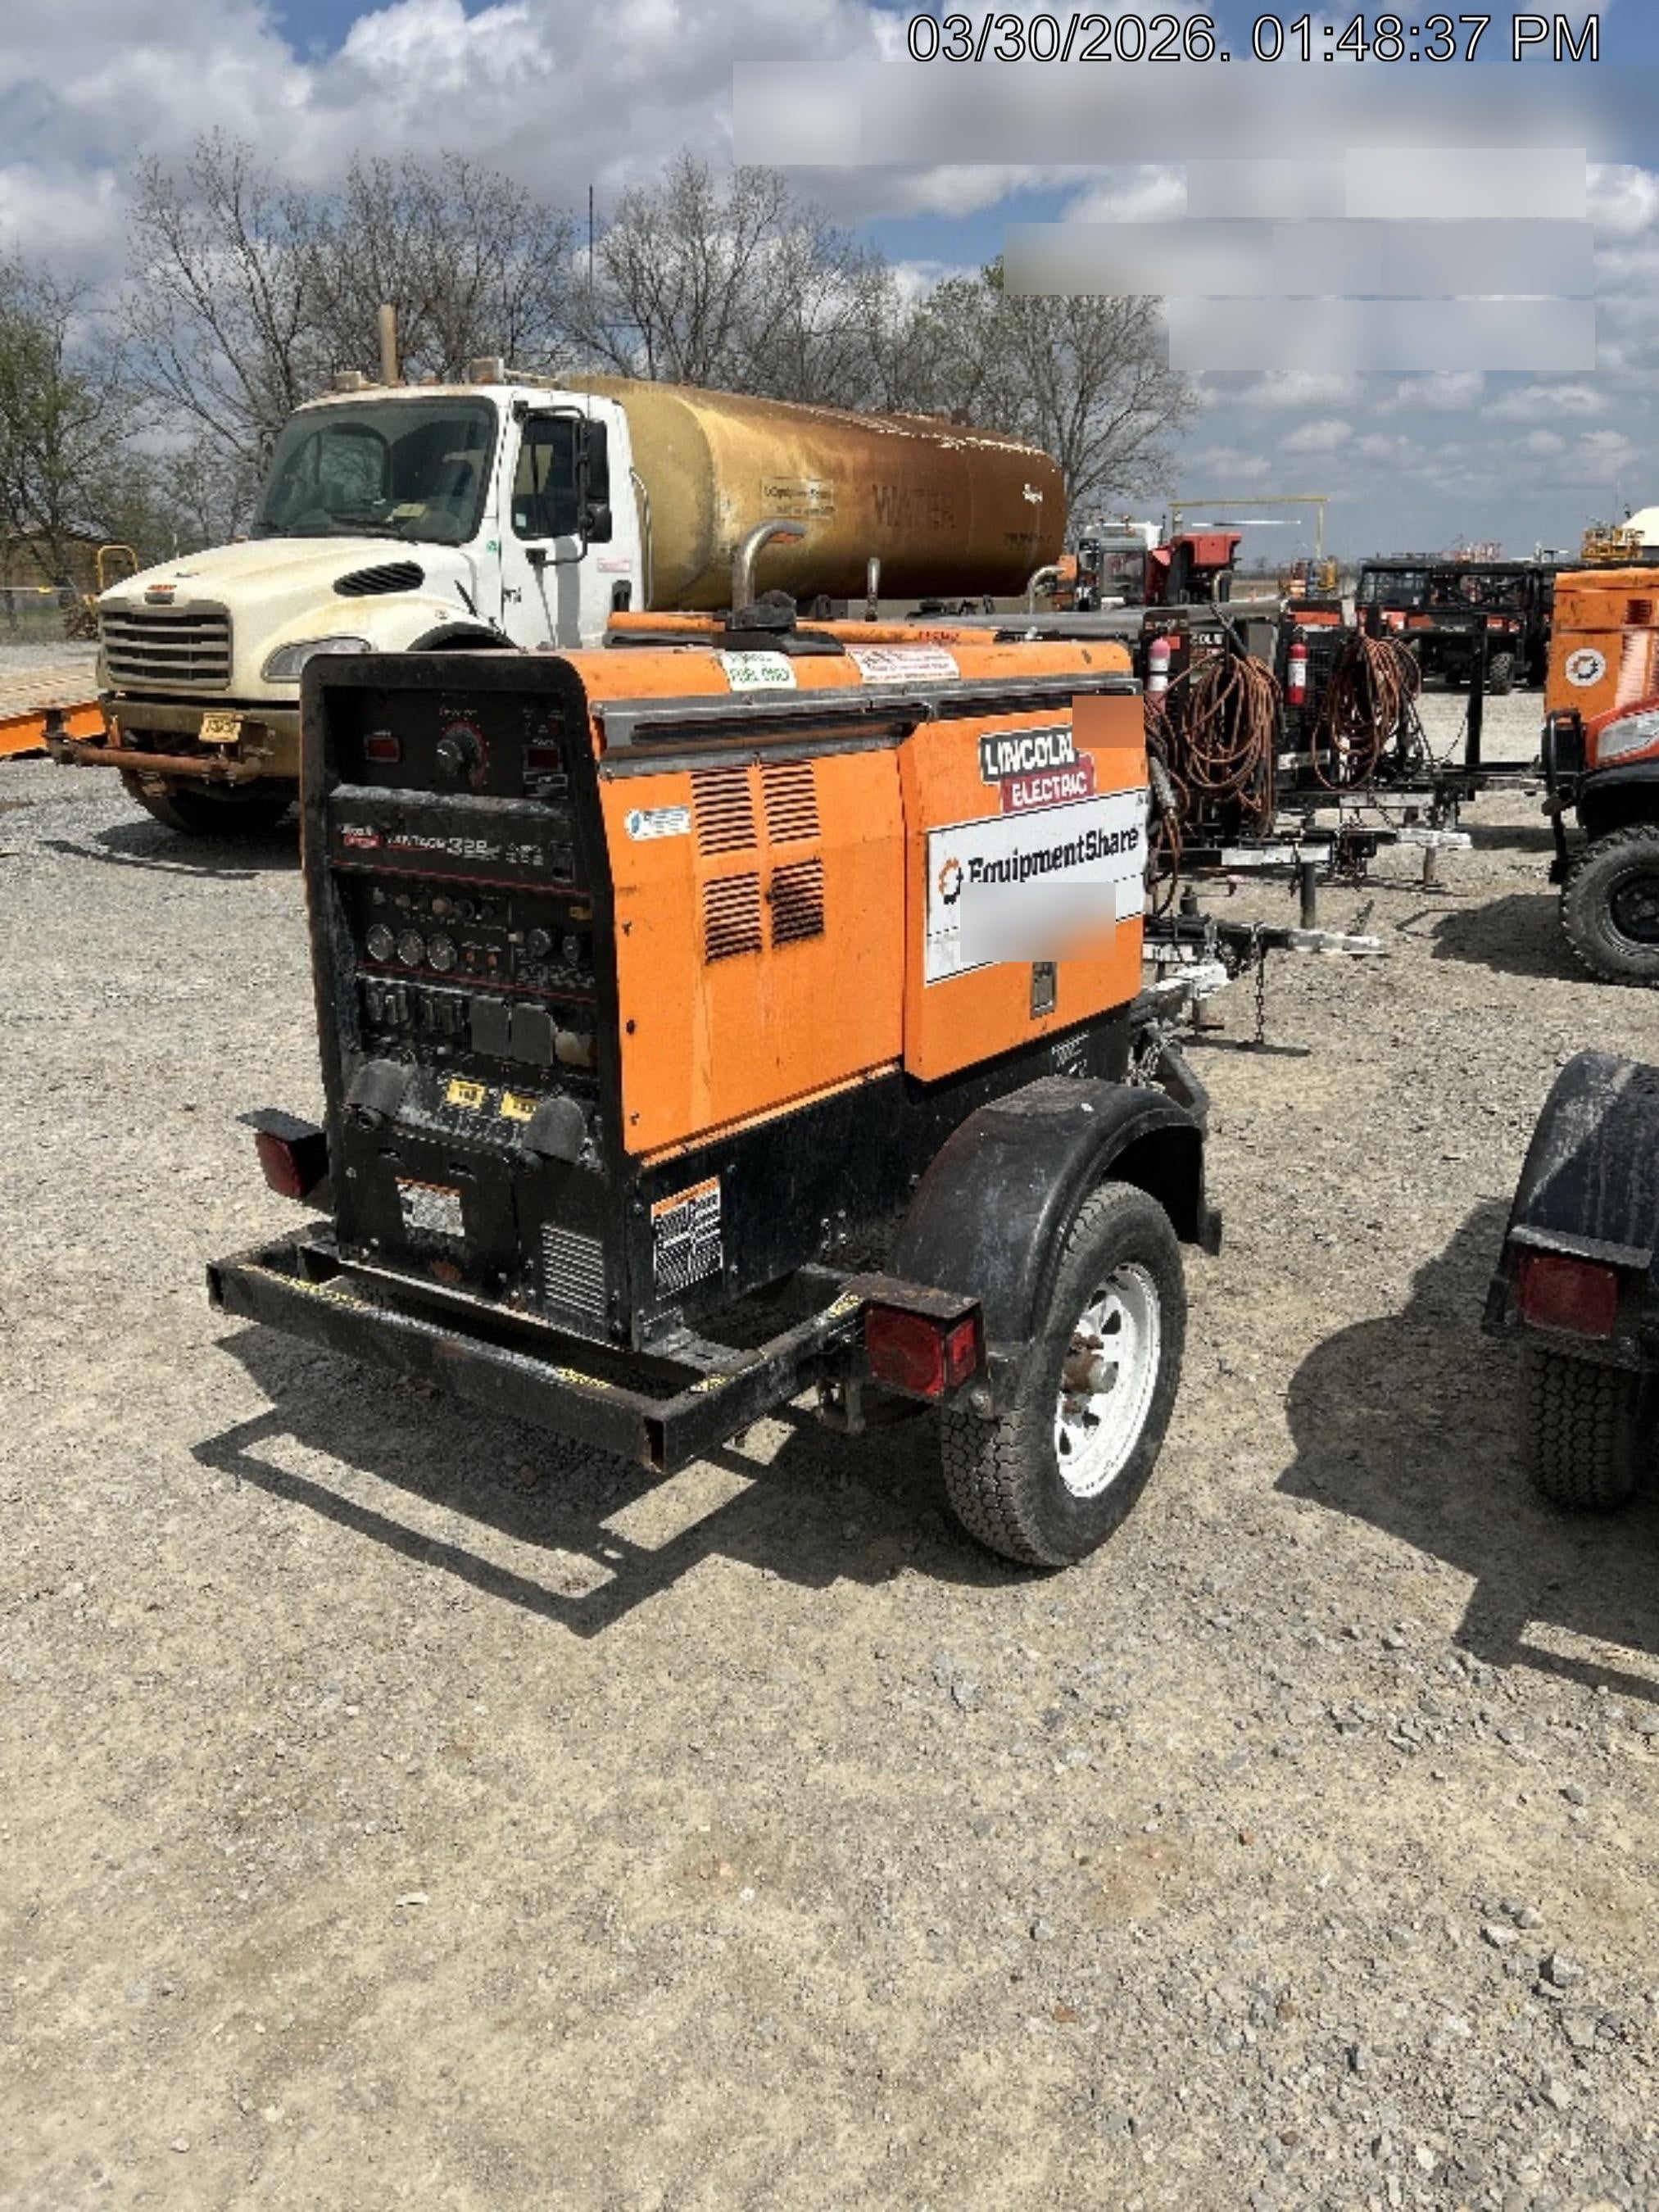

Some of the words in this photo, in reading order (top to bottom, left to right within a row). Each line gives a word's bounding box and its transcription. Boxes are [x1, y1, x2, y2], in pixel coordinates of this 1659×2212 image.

[986, 731, 1075, 775] LINCOLN
[1012, 772, 1087, 807] ELECTRIC
[968, 827, 1139, 883] EquipmentShare
